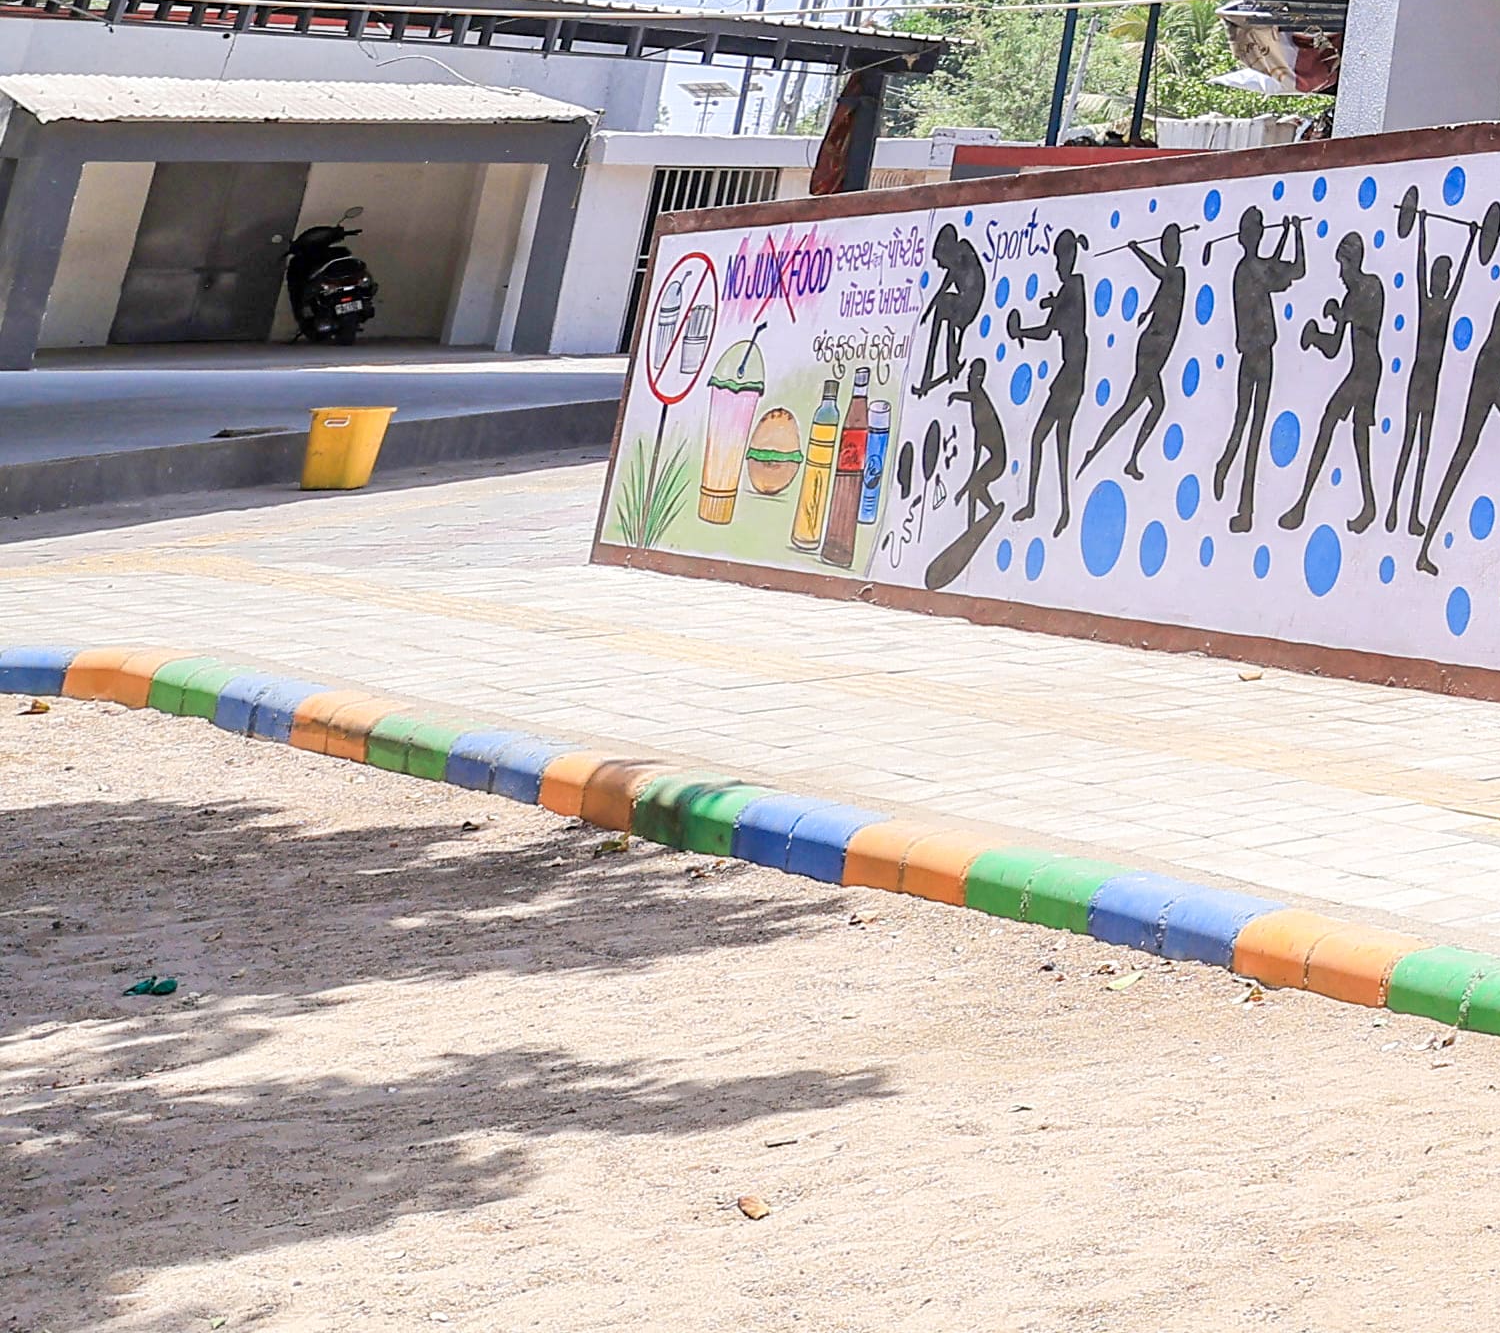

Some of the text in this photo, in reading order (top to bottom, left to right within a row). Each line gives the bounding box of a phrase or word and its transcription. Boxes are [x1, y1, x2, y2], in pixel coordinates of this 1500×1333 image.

[721, 246, 832, 301] NO JUNK FOOD
[982, 206, 1053, 282] Sports
